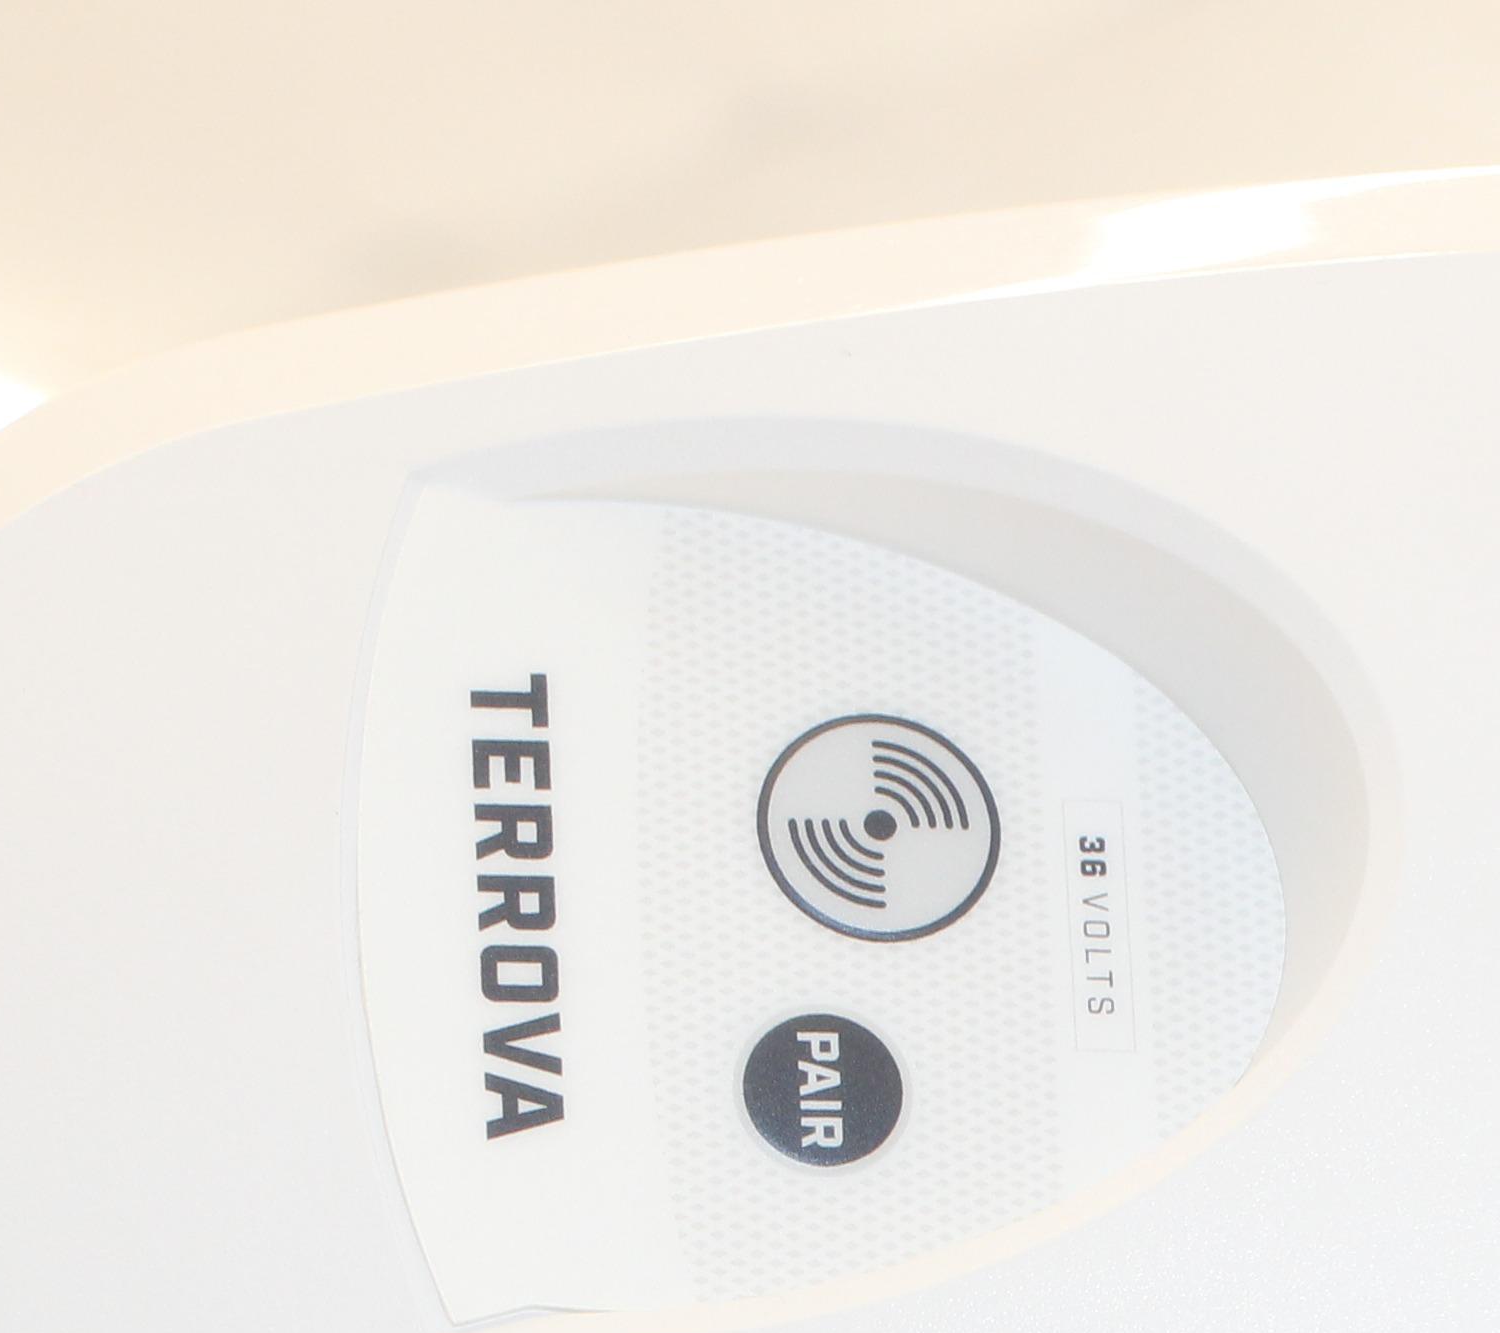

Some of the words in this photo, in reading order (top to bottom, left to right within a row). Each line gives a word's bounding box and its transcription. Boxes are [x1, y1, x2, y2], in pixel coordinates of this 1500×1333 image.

[470, 673, 565, 1140] TERROVA
[1077, 835, 1108, 878] 36
[1081, 892, 1116, 1016] VOLTS
[795, 1031, 844, 1149] PAIR
